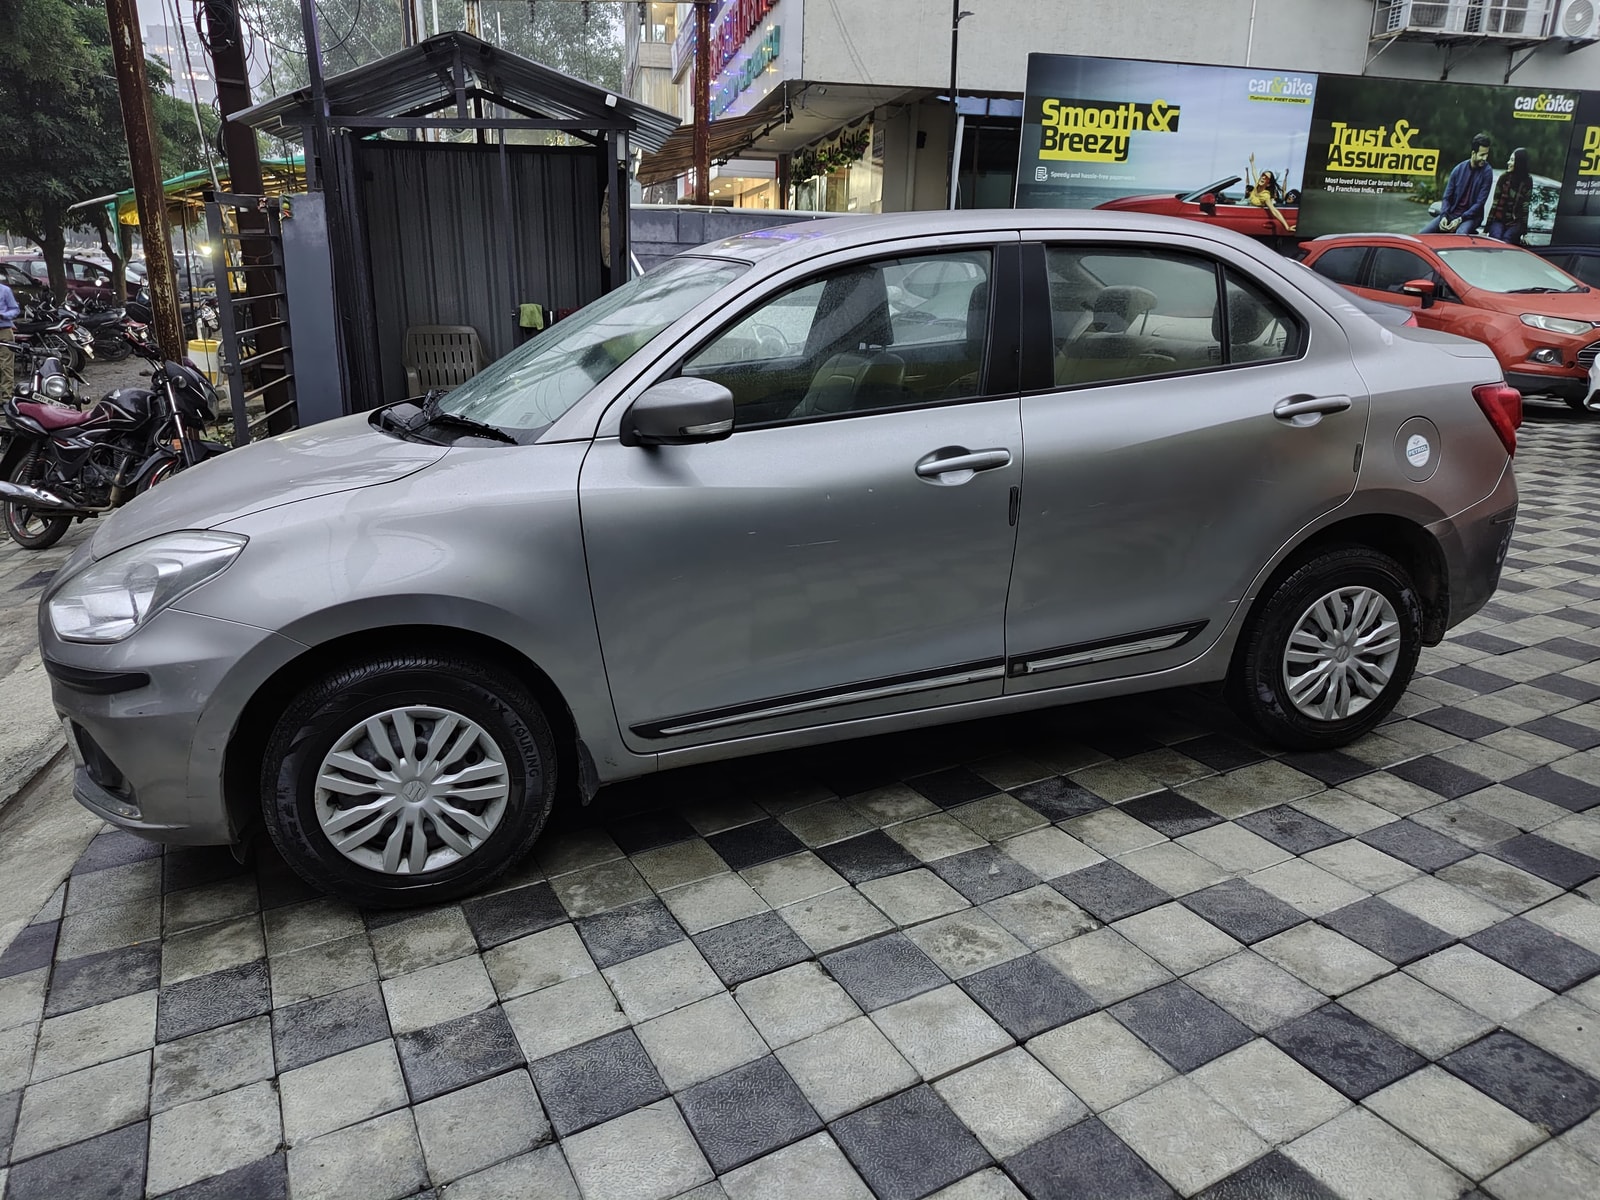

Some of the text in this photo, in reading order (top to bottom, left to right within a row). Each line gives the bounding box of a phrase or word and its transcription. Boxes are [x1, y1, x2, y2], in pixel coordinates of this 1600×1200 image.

[1248, 76, 1313, 96] car&bike
[1514, 93, 1575, 113] car&bike
[1042, 98, 1180, 132] Smooth &
[1040, 125, 1130, 162] Breezy
[1331, 119, 1419, 149] Trust &
[1583, 126, 1600, 150] D
[1327, 144, 1436, 172] Assurance
[1580, 149, 1600, 171] S
[1050, 171, 1070, 179] Speedy
[1339, 177, 1353, 185] loved
[1327, 185, 1335, 193] By
[1335, 185, 1361, 193] Franchise
[510, 719, 540, 778] TOURING
